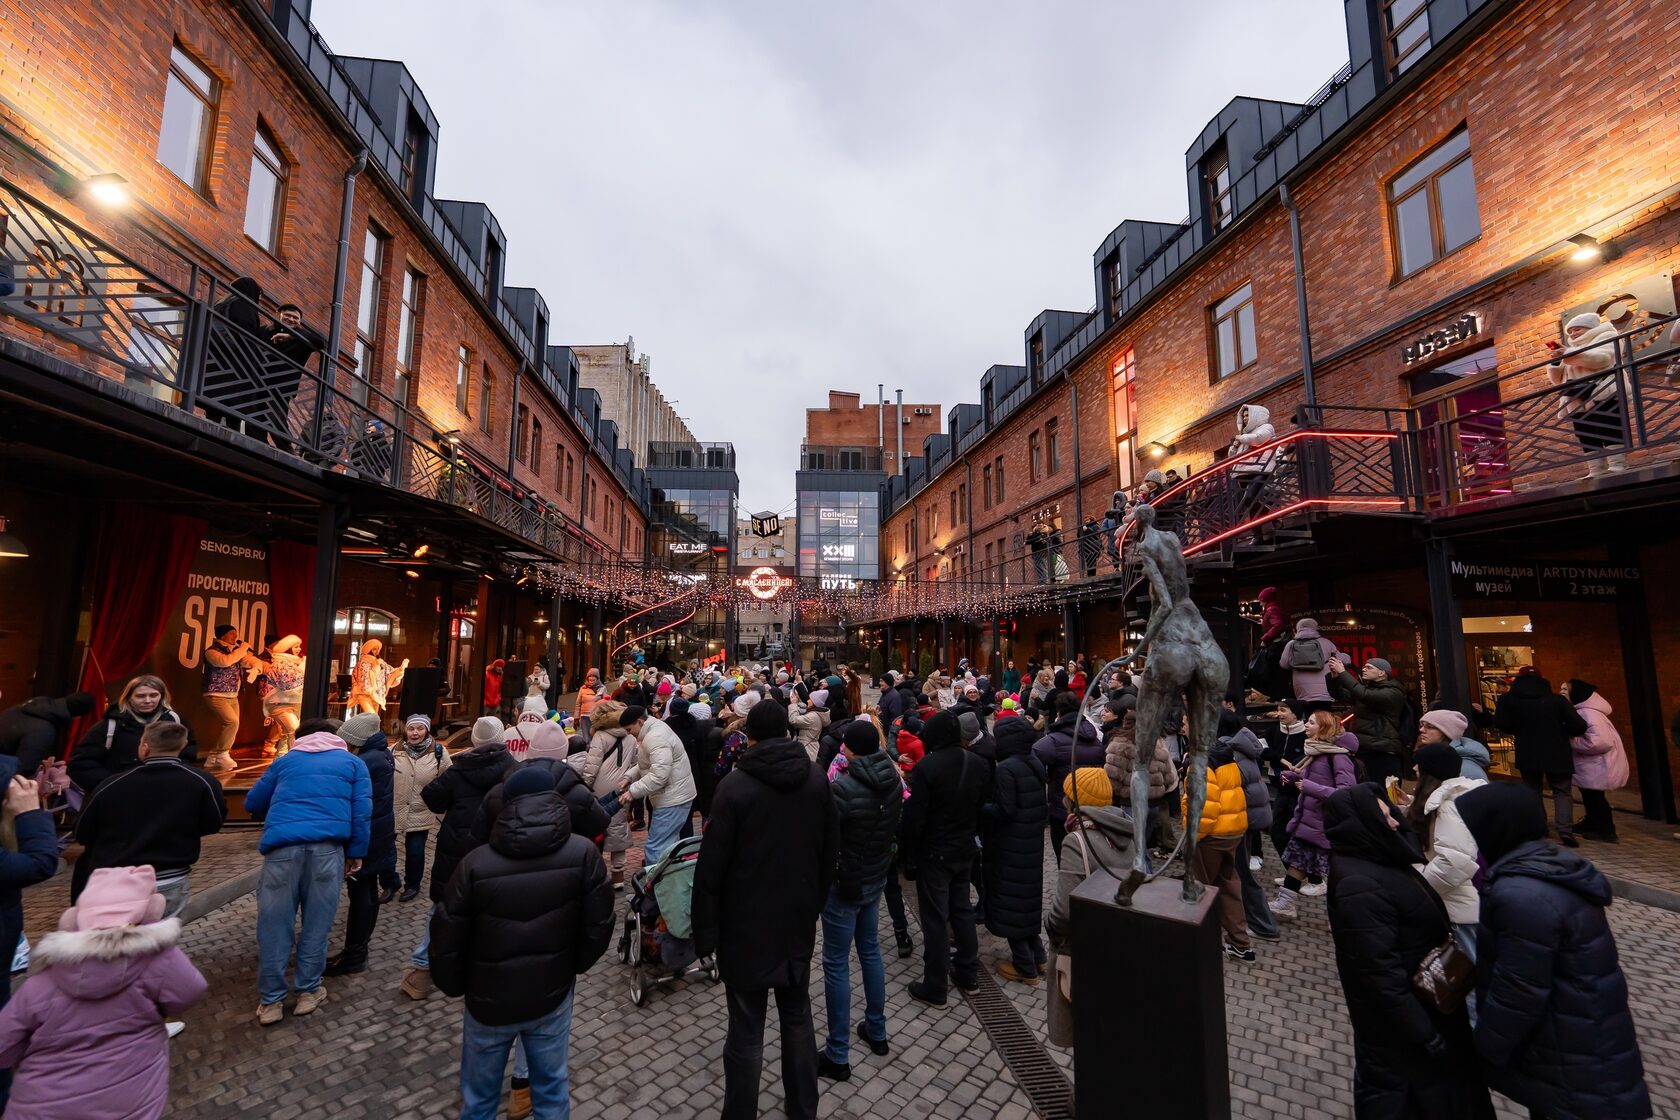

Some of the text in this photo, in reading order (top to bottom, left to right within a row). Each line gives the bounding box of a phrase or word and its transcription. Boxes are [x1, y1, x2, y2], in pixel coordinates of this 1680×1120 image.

[1402, 314, 1479, 364] МУЗЕЙ
[200, 539, 266, 561] SENO.SPB.RU
[1451, 560, 1536, 578] Мультимедиа
[1543, 566, 1641, 579] ARTDYNAMICS
[187, 573, 270, 596] ПРОСТРАНСТВО
[821, 579, 856, 590] ПУТЬ
[1475, 579, 1513, 596] музей
[1569, 582, 1617, 595] 2 этаж
[178, 595, 268, 672] SENO
